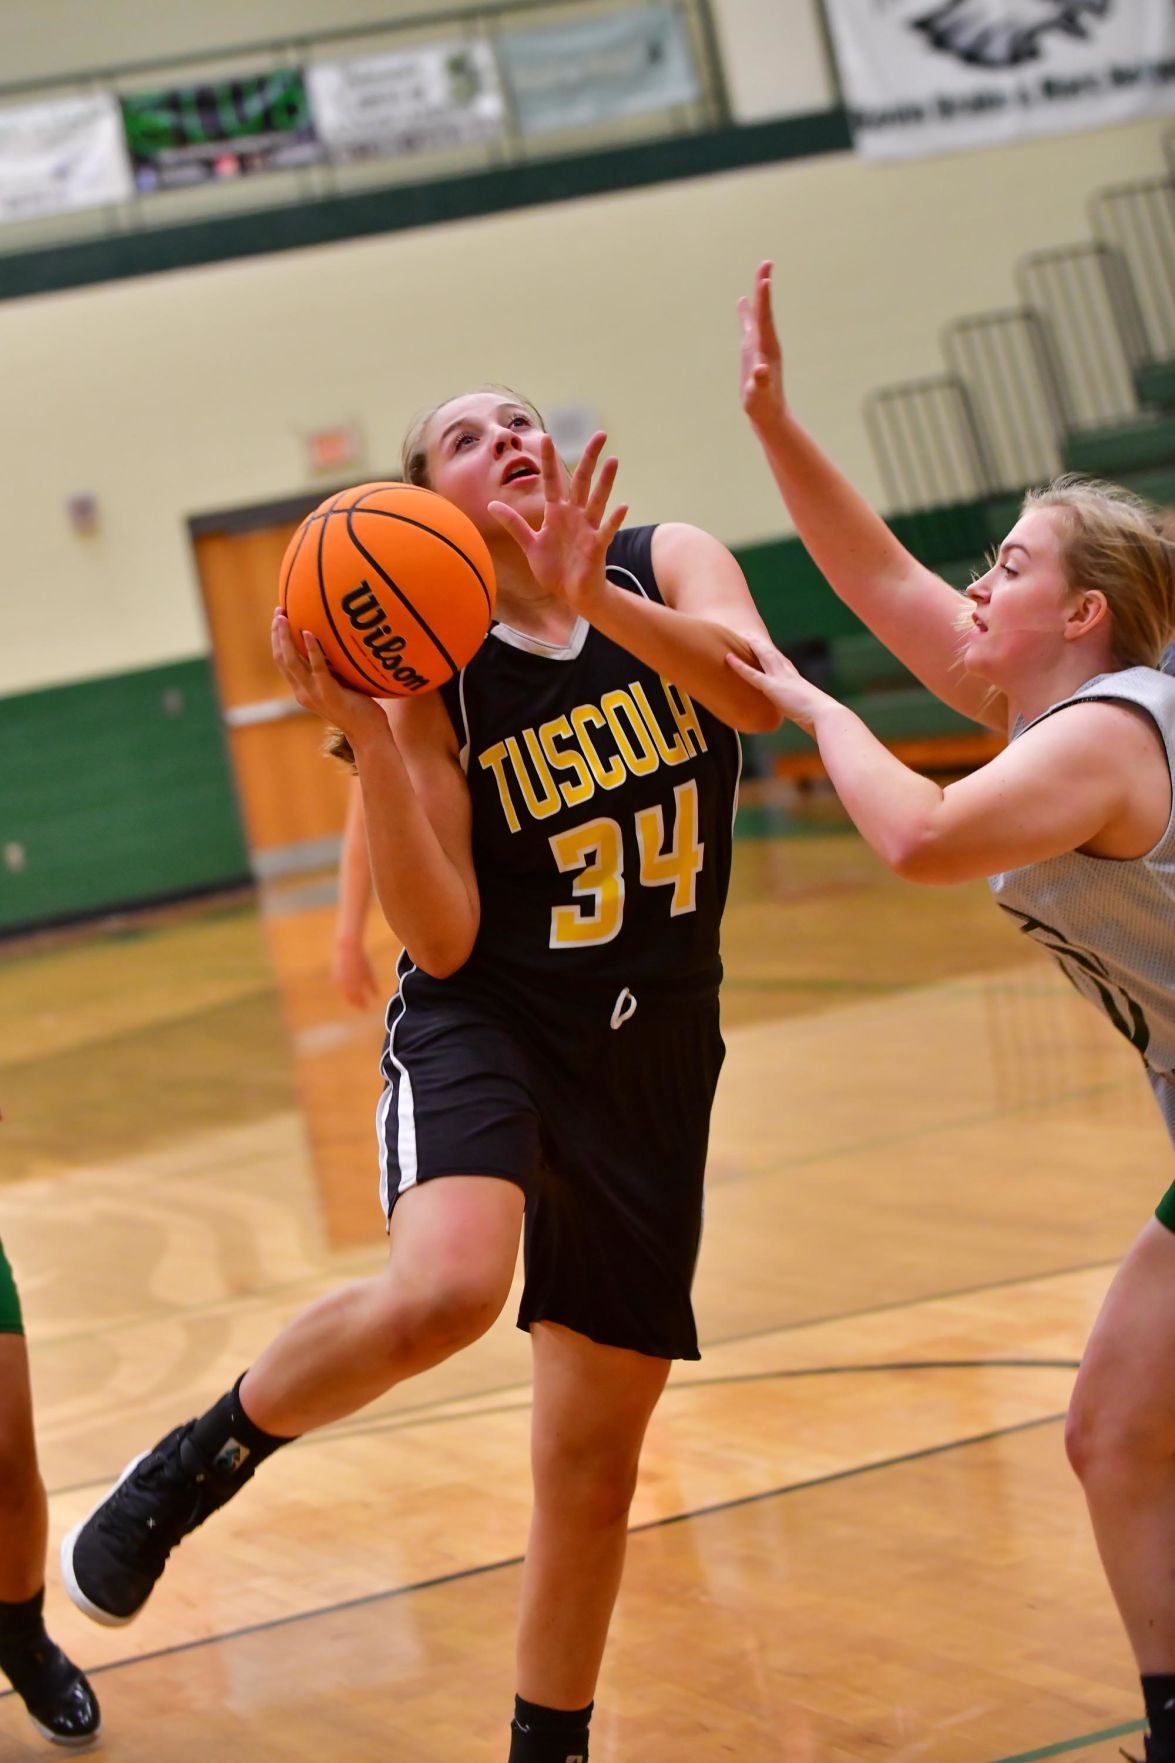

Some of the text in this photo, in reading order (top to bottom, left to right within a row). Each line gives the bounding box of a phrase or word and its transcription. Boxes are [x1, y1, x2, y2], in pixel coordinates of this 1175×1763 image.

[341, 580, 430, 691] Wilson
[478, 677, 708, 834] TUSCOLA
[548, 778, 705, 949] 34
